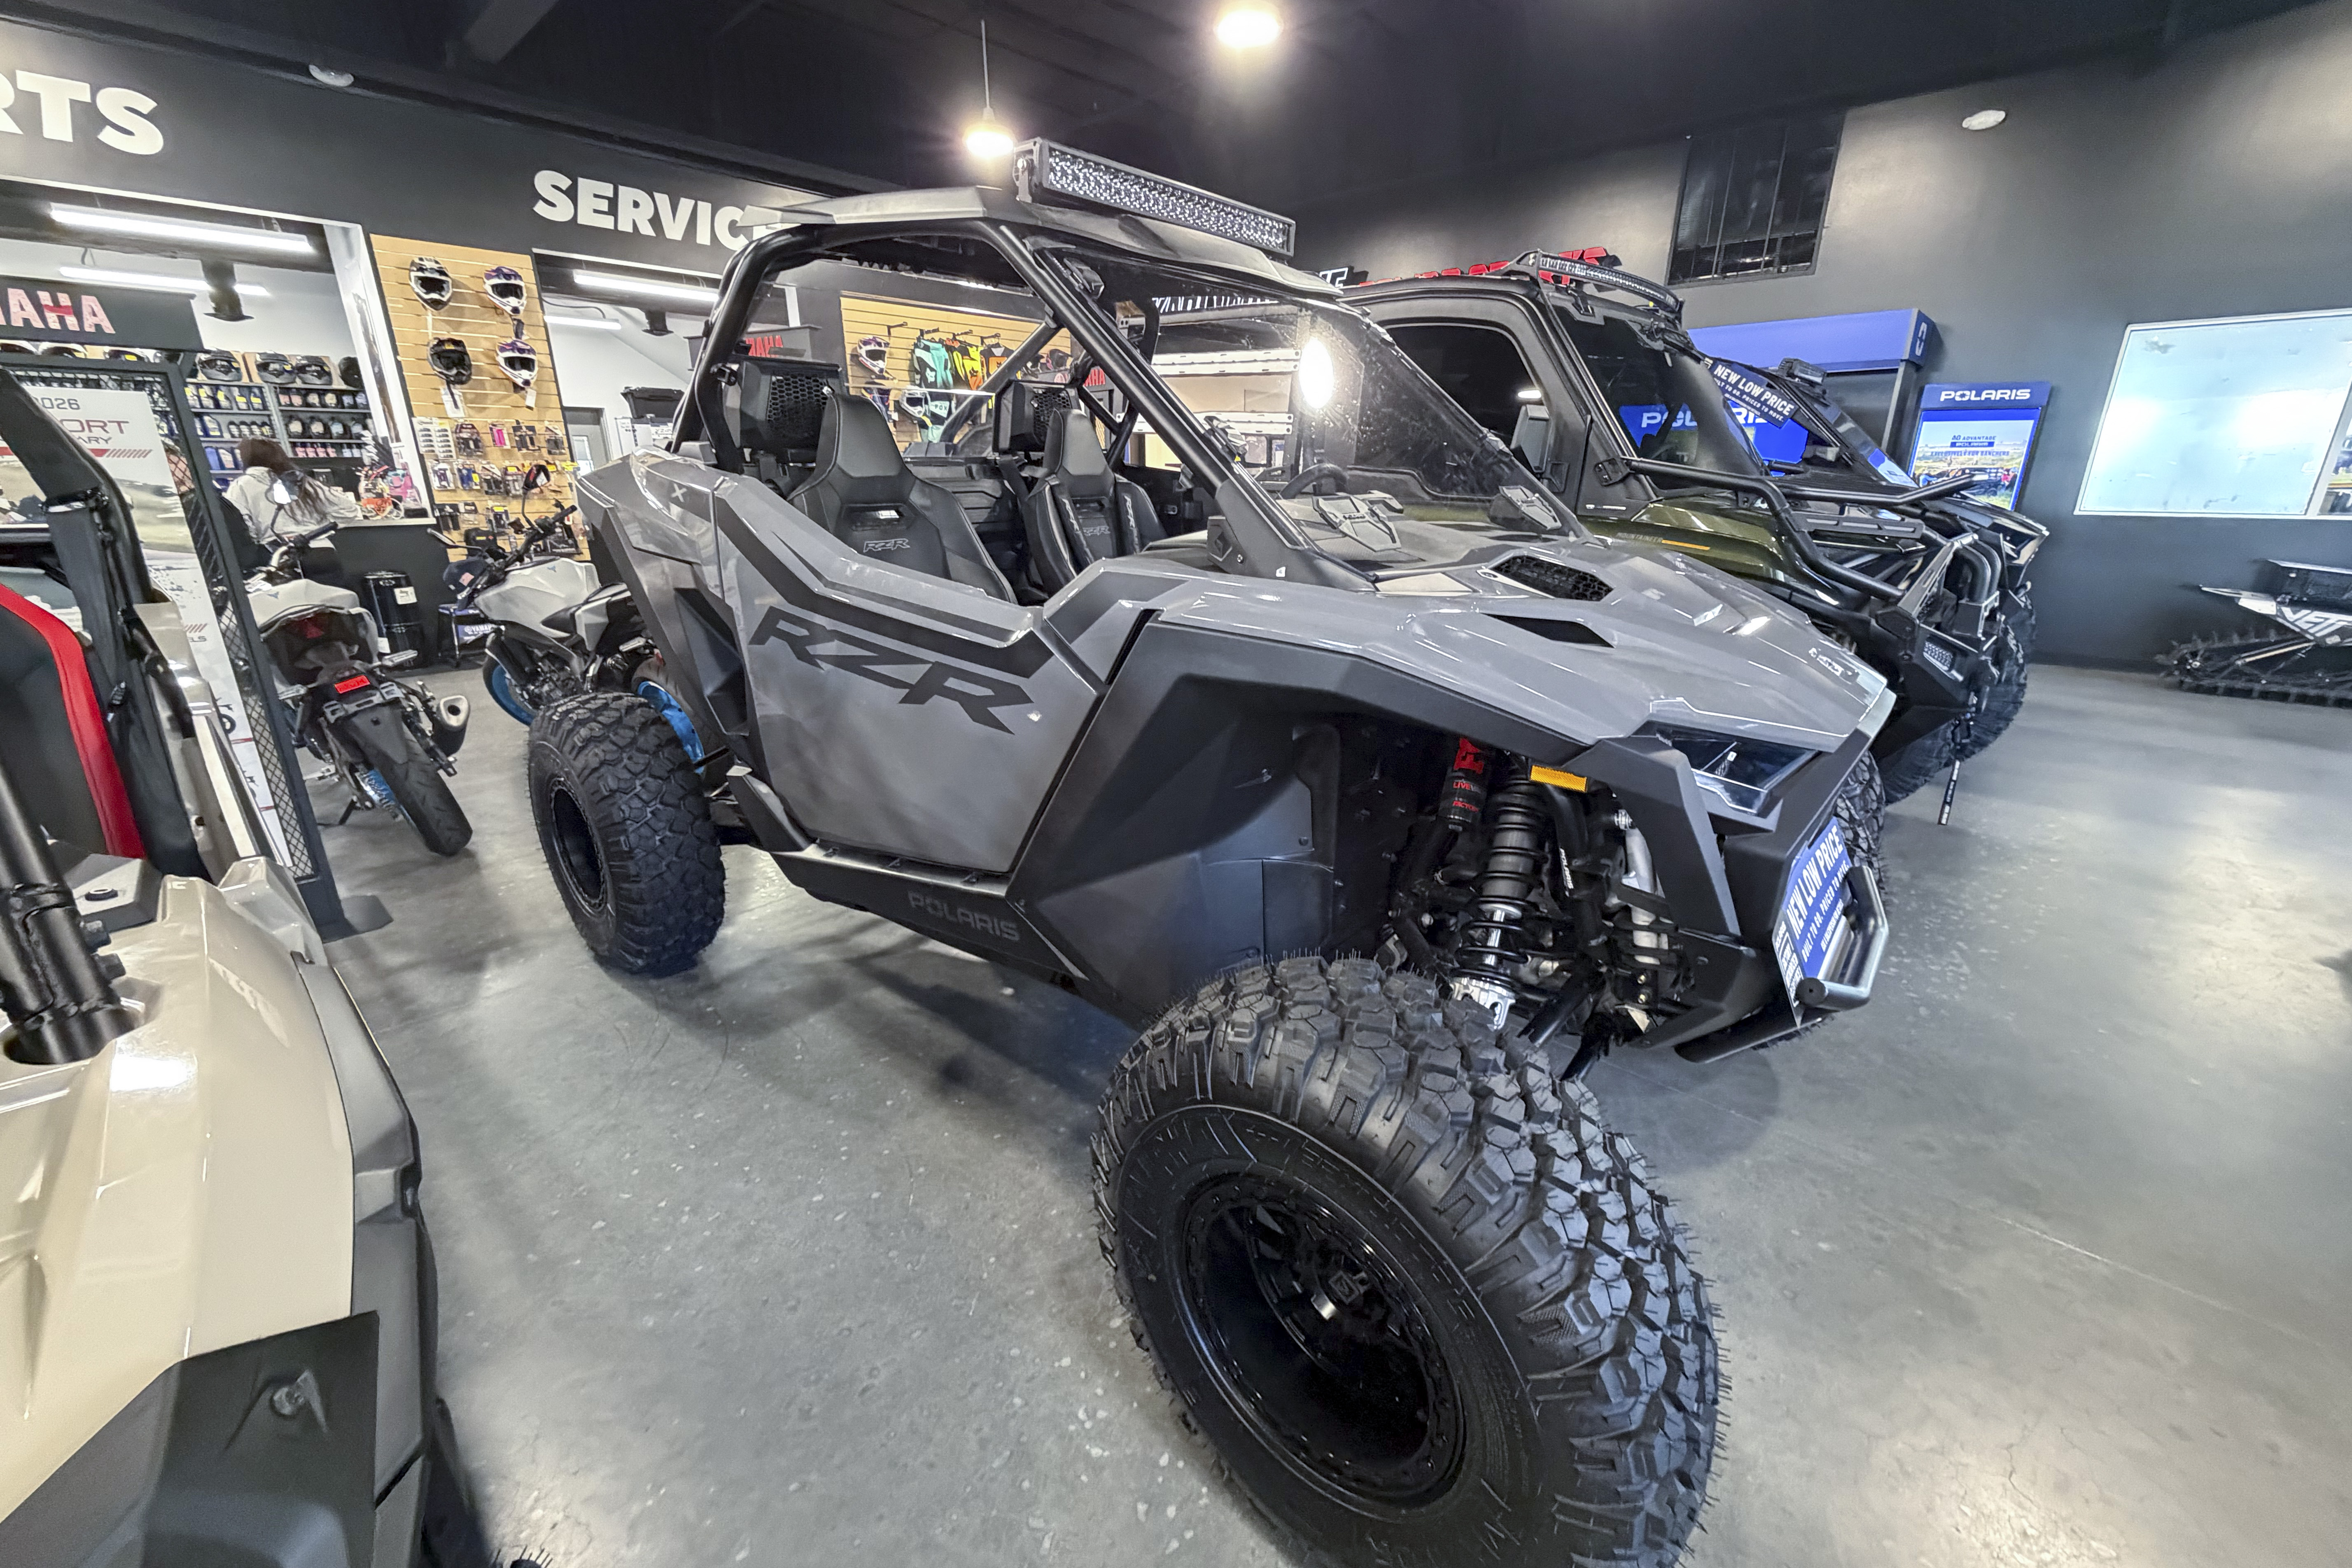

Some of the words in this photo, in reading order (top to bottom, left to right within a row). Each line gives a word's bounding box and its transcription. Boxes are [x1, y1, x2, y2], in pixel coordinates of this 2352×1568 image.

[0, 288, 116, 334] AHA
[1714, 365, 1741, 385] NEW
[1738, 378, 1764, 398] LOW
[1760, 391, 1795, 416] PRICE
[1940, 389, 2030, 401] POLARIS
[863, 538, 910, 553] RZR
[749, 606, 1034, 735] RZR
[1559, 847, 1574, 889] POLARIS
[1787, 884, 1808, 940] NEW
[1798, 856, 1822, 907] LOW
[1815, 825, 1843, 879] PRICE
[908, 891, 1020, 942] POLARIS
[1801, 933, 1814, 963] BUILT
[1810, 922, 1818, 939] TO
[1820, 885, 1835, 916] PRICED
[1832, 876, 1840, 891] TO
